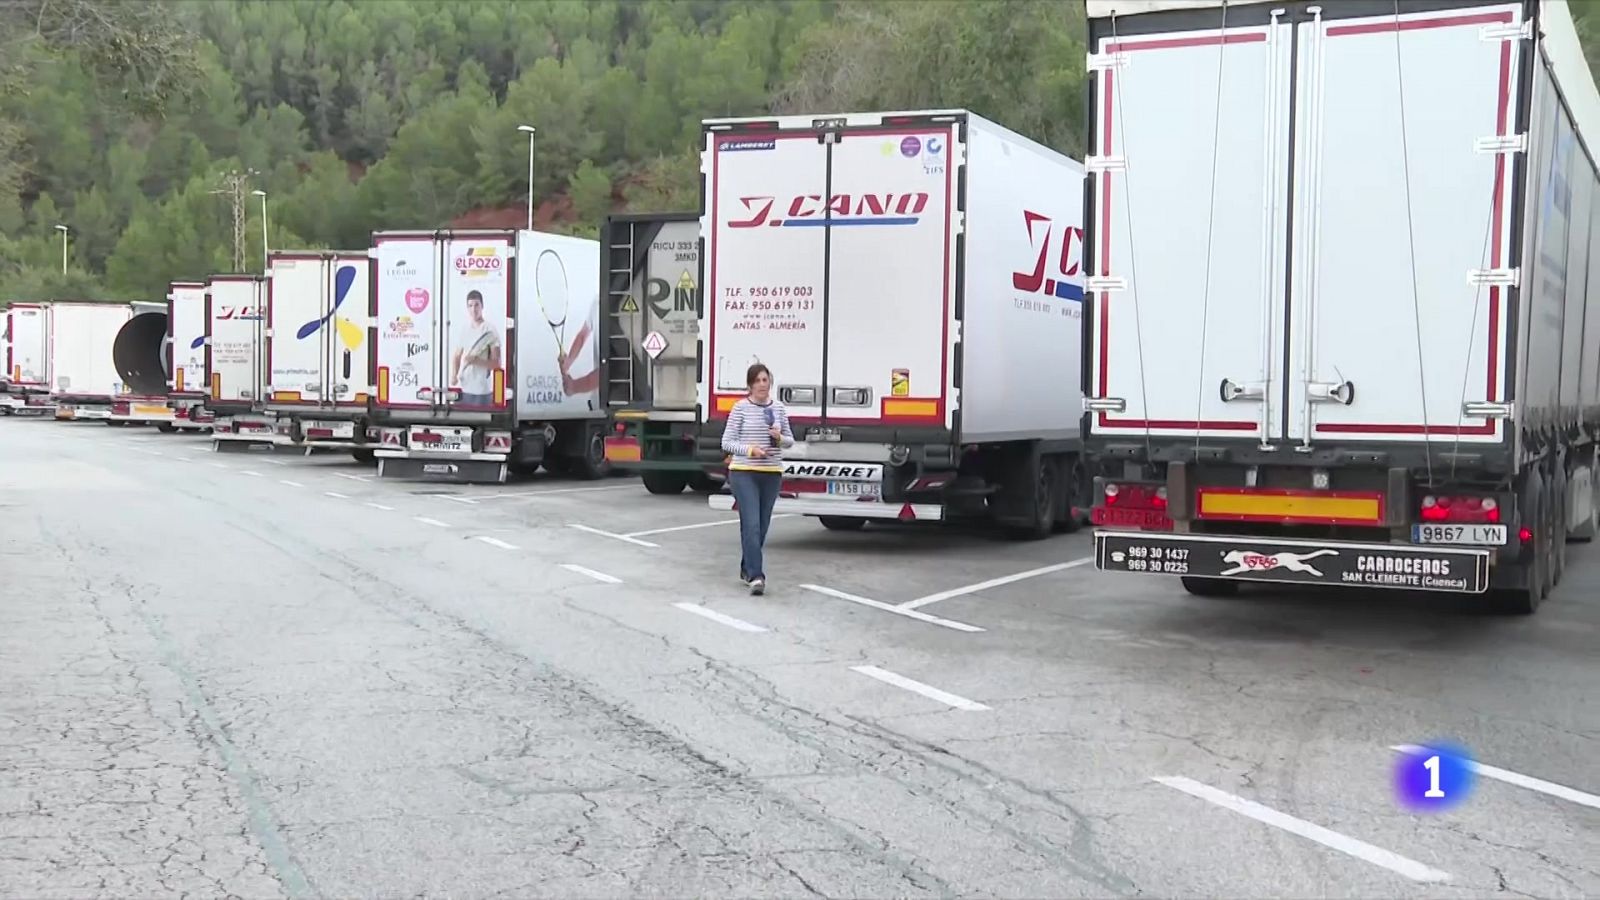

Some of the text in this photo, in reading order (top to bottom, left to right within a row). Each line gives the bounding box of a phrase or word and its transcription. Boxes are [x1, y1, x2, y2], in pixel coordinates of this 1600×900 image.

[653, 241, 675, 250] RICU
[749, 287, 768, 297] 950
[771, 287, 791, 297] 619
[793, 286, 813, 297] 003
[752, 301, 771, 310] 950
[774, 301, 793, 310] 619
[797, 300, 815, 310] 131
[732, 322, 760, 330] ANTAS
[407, 343, 429, 358] King
[392, 372, 418, 386] 1954
[526, 375, 559, 389] CARLOS
[526, 391, 562, 404] ALCARAZ
[1423, 527, 1501, 542] 9867 LYN
[1128, 547, 1189, 559] 969 30 1437
[1128, 560, 1189, 573] 969 30 0225
[1357, 556, 1450, 575] CARROCEROS
[1342, 571, 1468, 591] SAN CLEMENTE (Cuenca)
